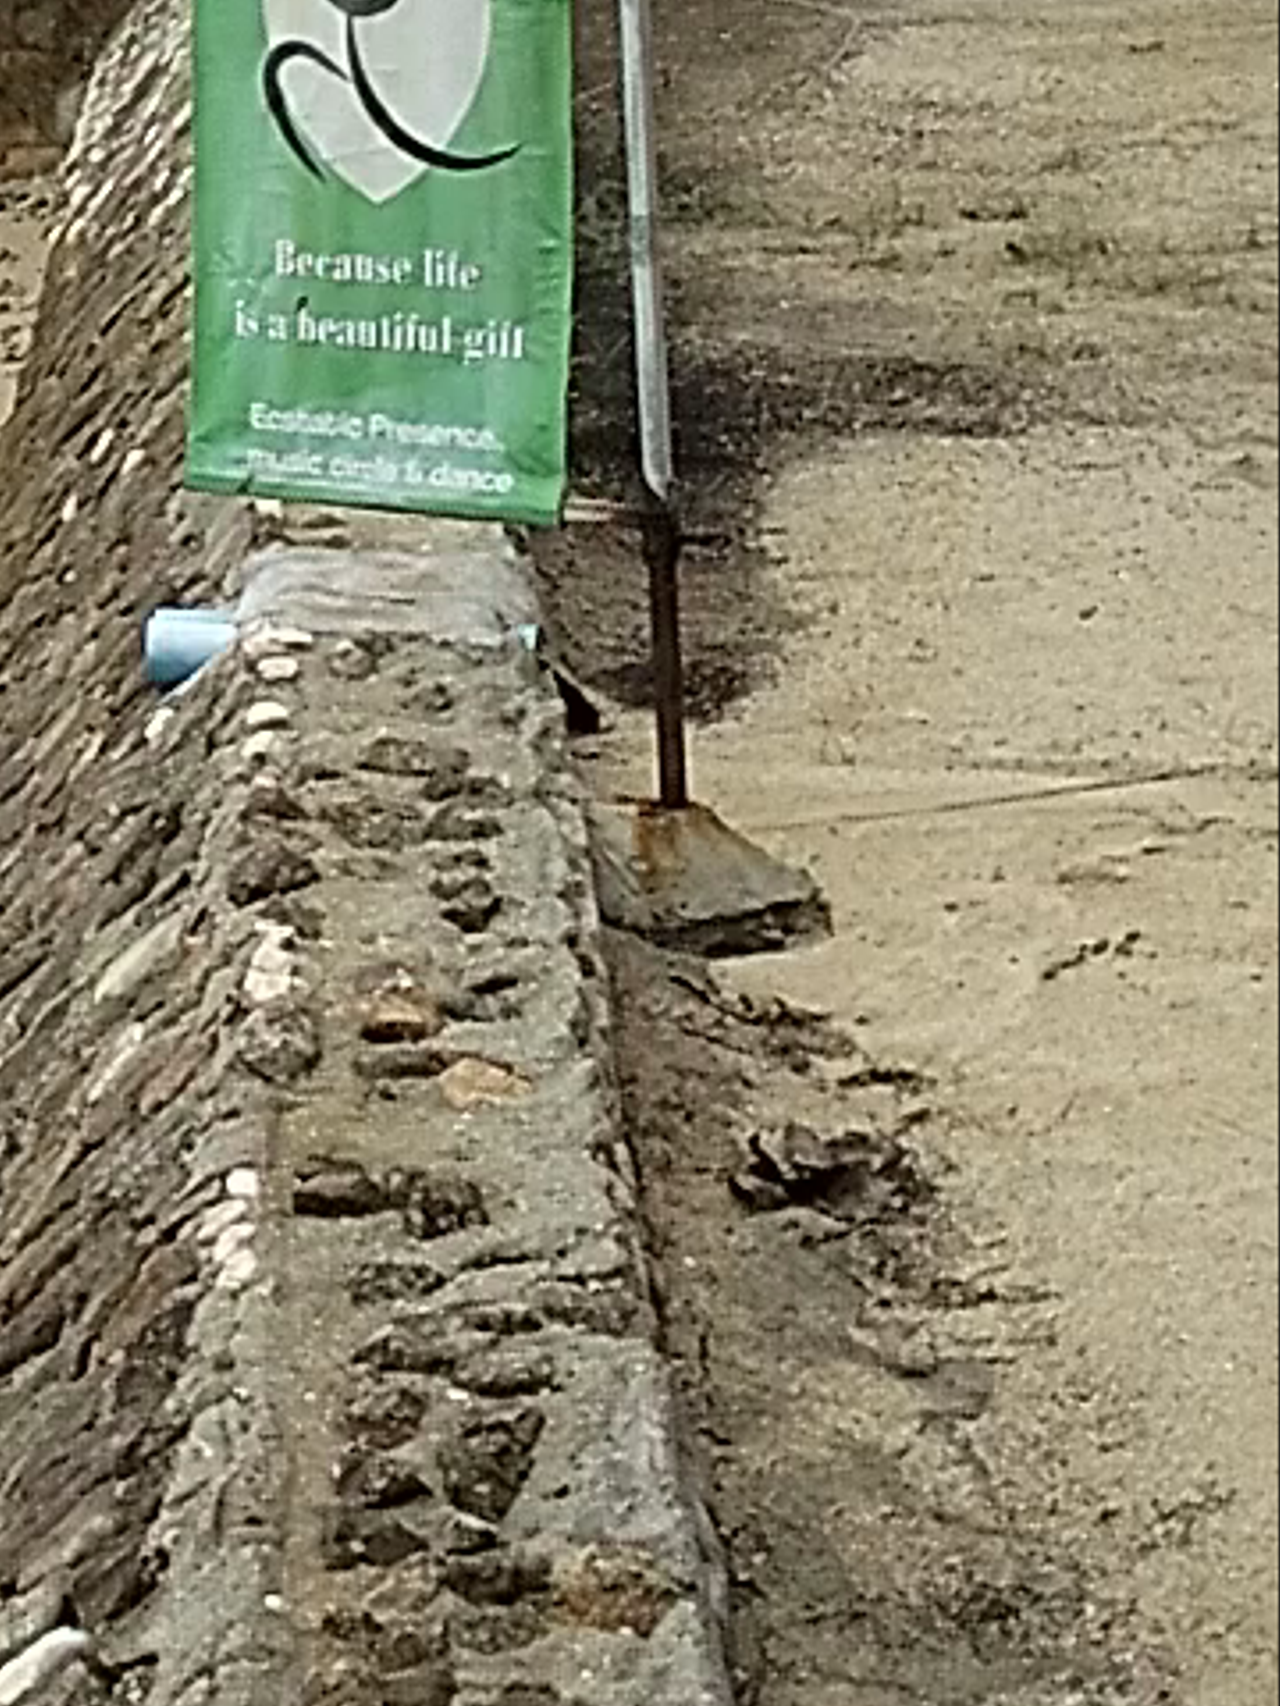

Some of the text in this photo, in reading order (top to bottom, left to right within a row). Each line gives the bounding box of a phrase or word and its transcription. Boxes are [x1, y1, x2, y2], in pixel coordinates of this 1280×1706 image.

[275, 239, 482, 289] Because life
[235, 298, 524, 365] is a beautiful gift
[429, 460, 515, 493] dance
